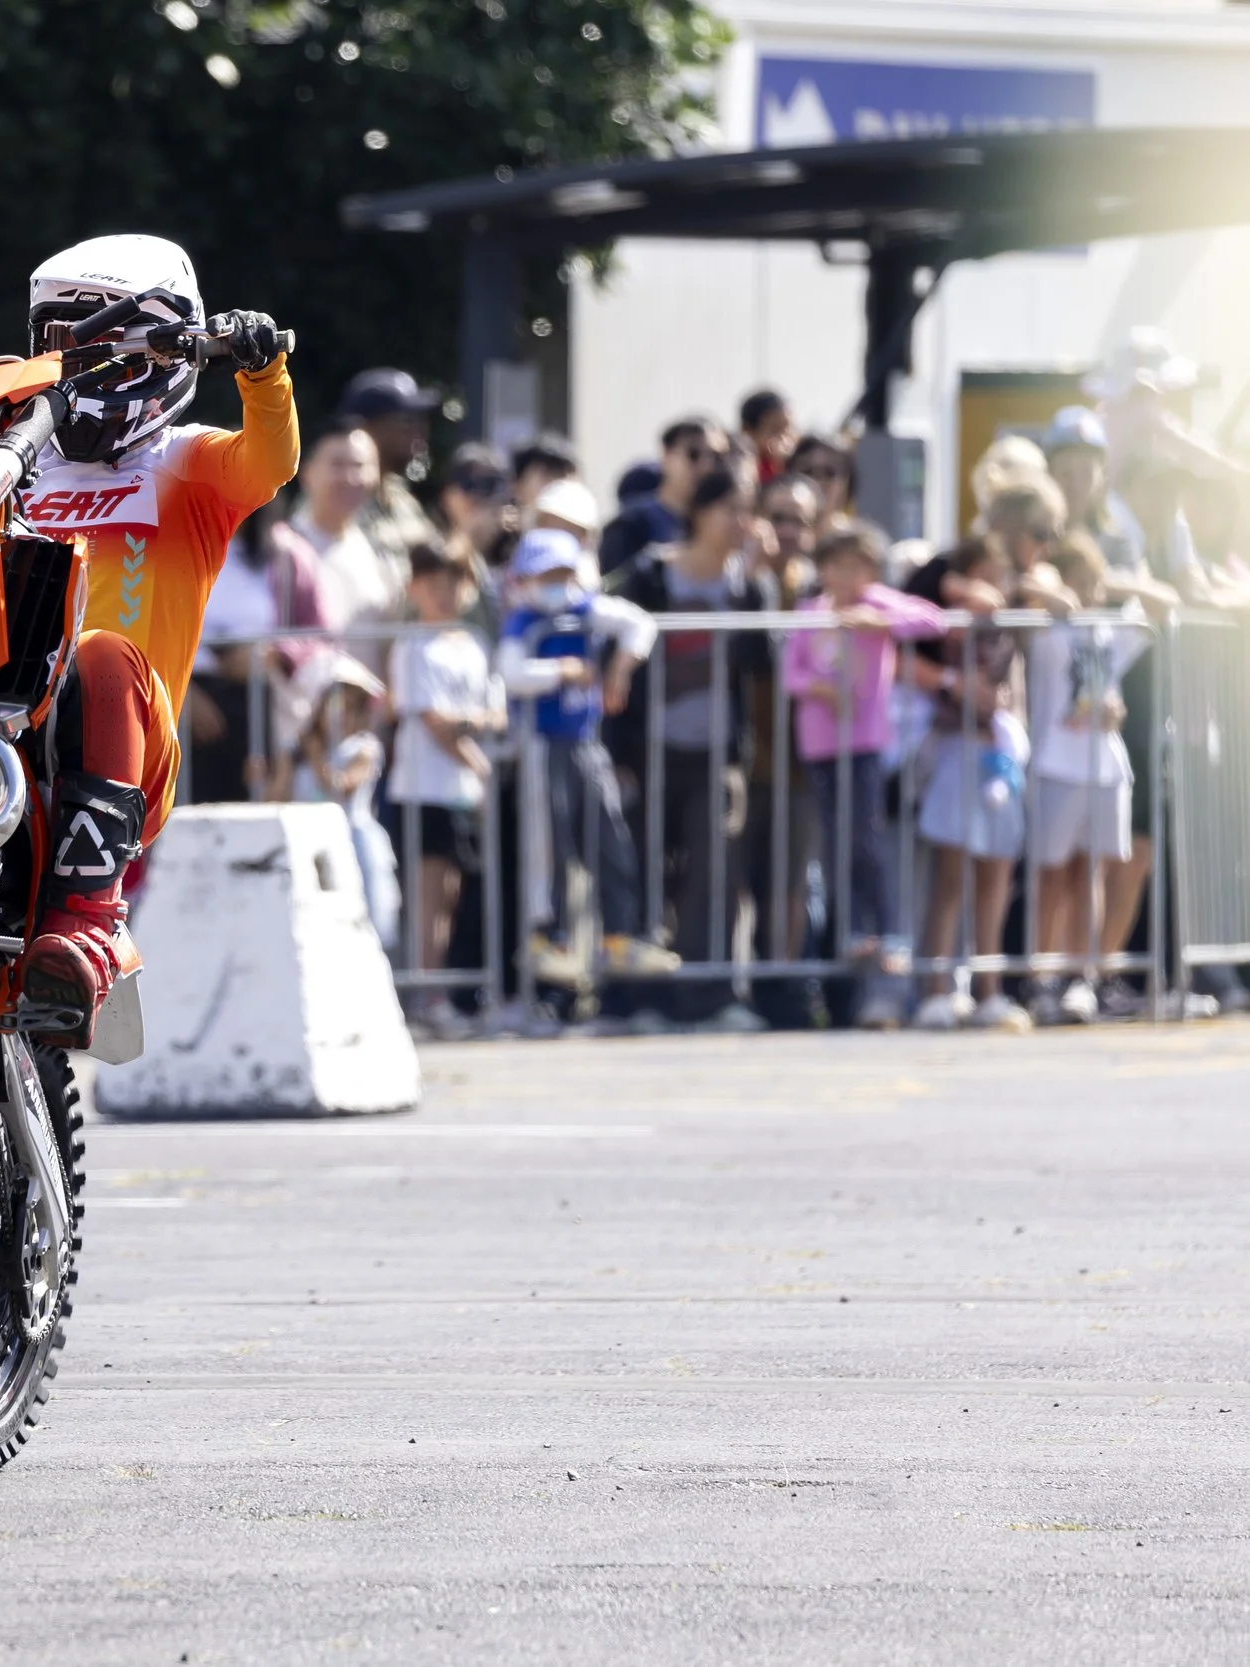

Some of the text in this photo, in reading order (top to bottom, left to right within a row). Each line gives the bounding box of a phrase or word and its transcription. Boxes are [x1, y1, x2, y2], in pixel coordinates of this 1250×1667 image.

[79, 272, 131, 284] LEATT
[79, 293, 101, 303] LEATT
[13, 485, 141, 522] LEATT
